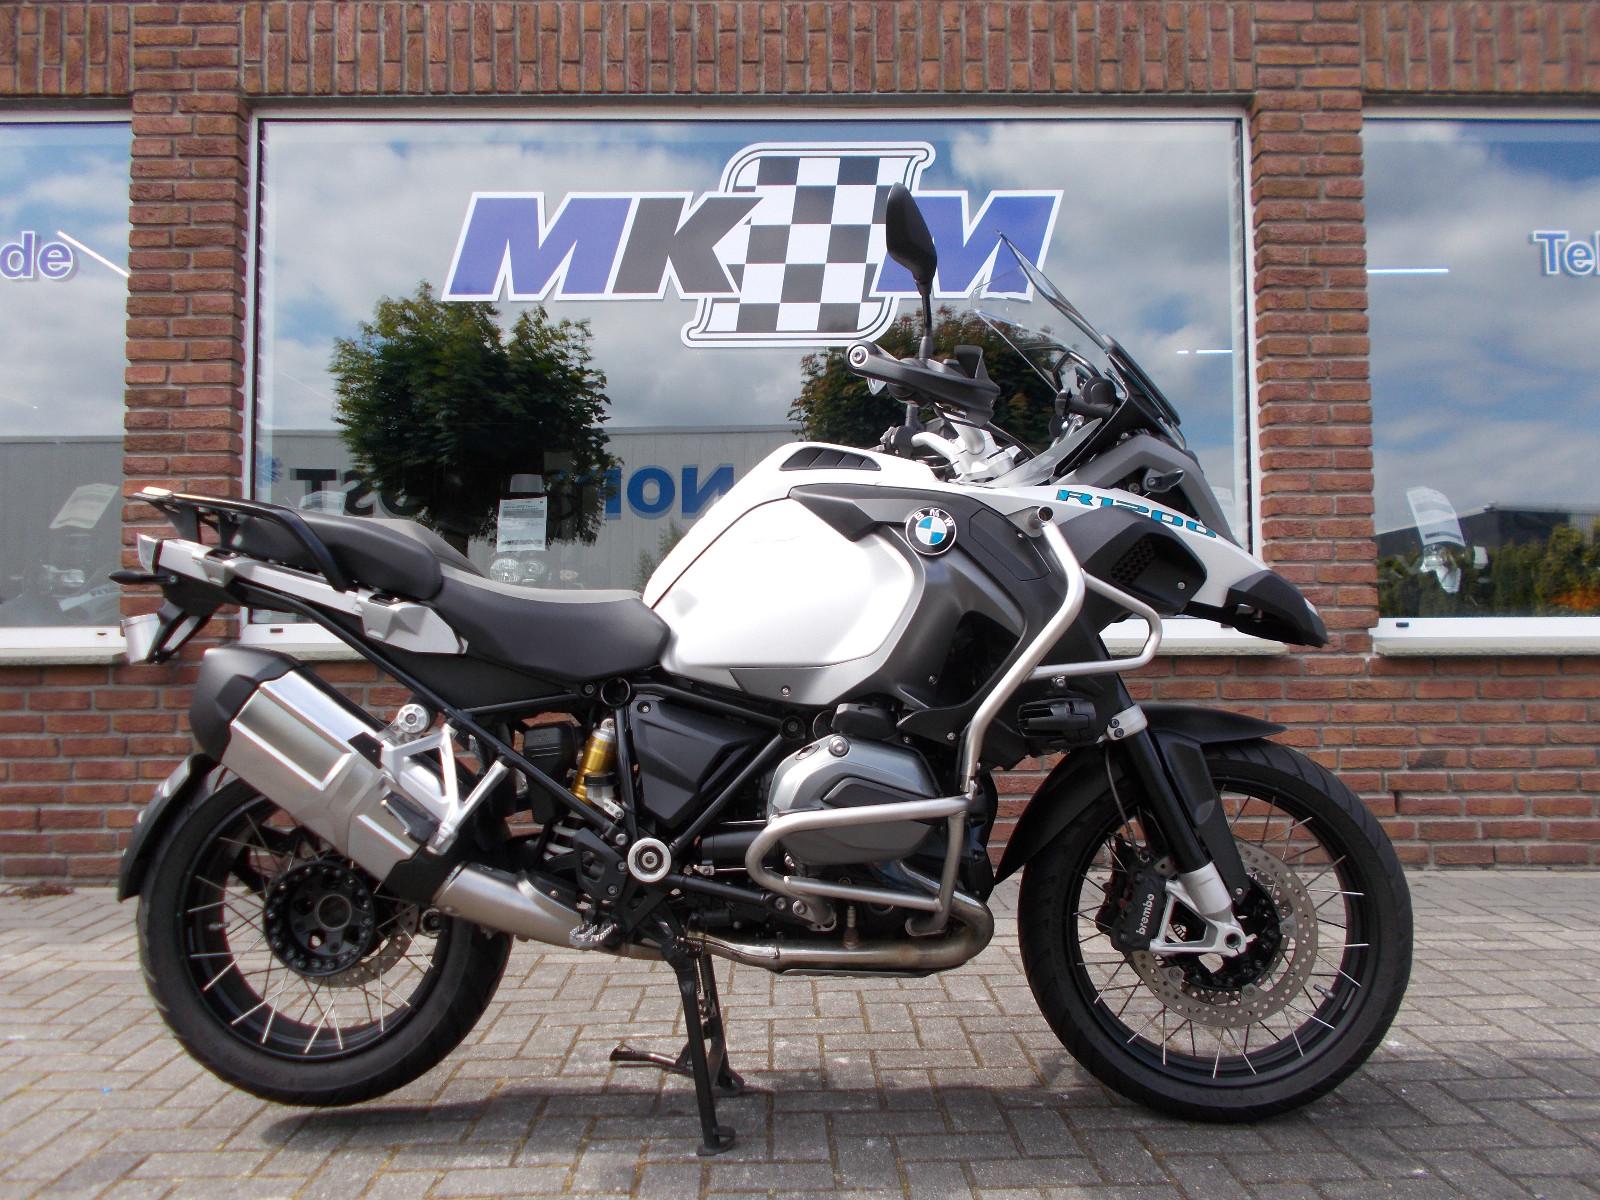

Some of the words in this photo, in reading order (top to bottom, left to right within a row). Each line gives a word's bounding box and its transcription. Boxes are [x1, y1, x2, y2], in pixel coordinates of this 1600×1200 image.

[913, 508, 954, 527] BMW
[1056, 489, 1217, 539] R1200
[1135, 893, 1155, 936] brembo
